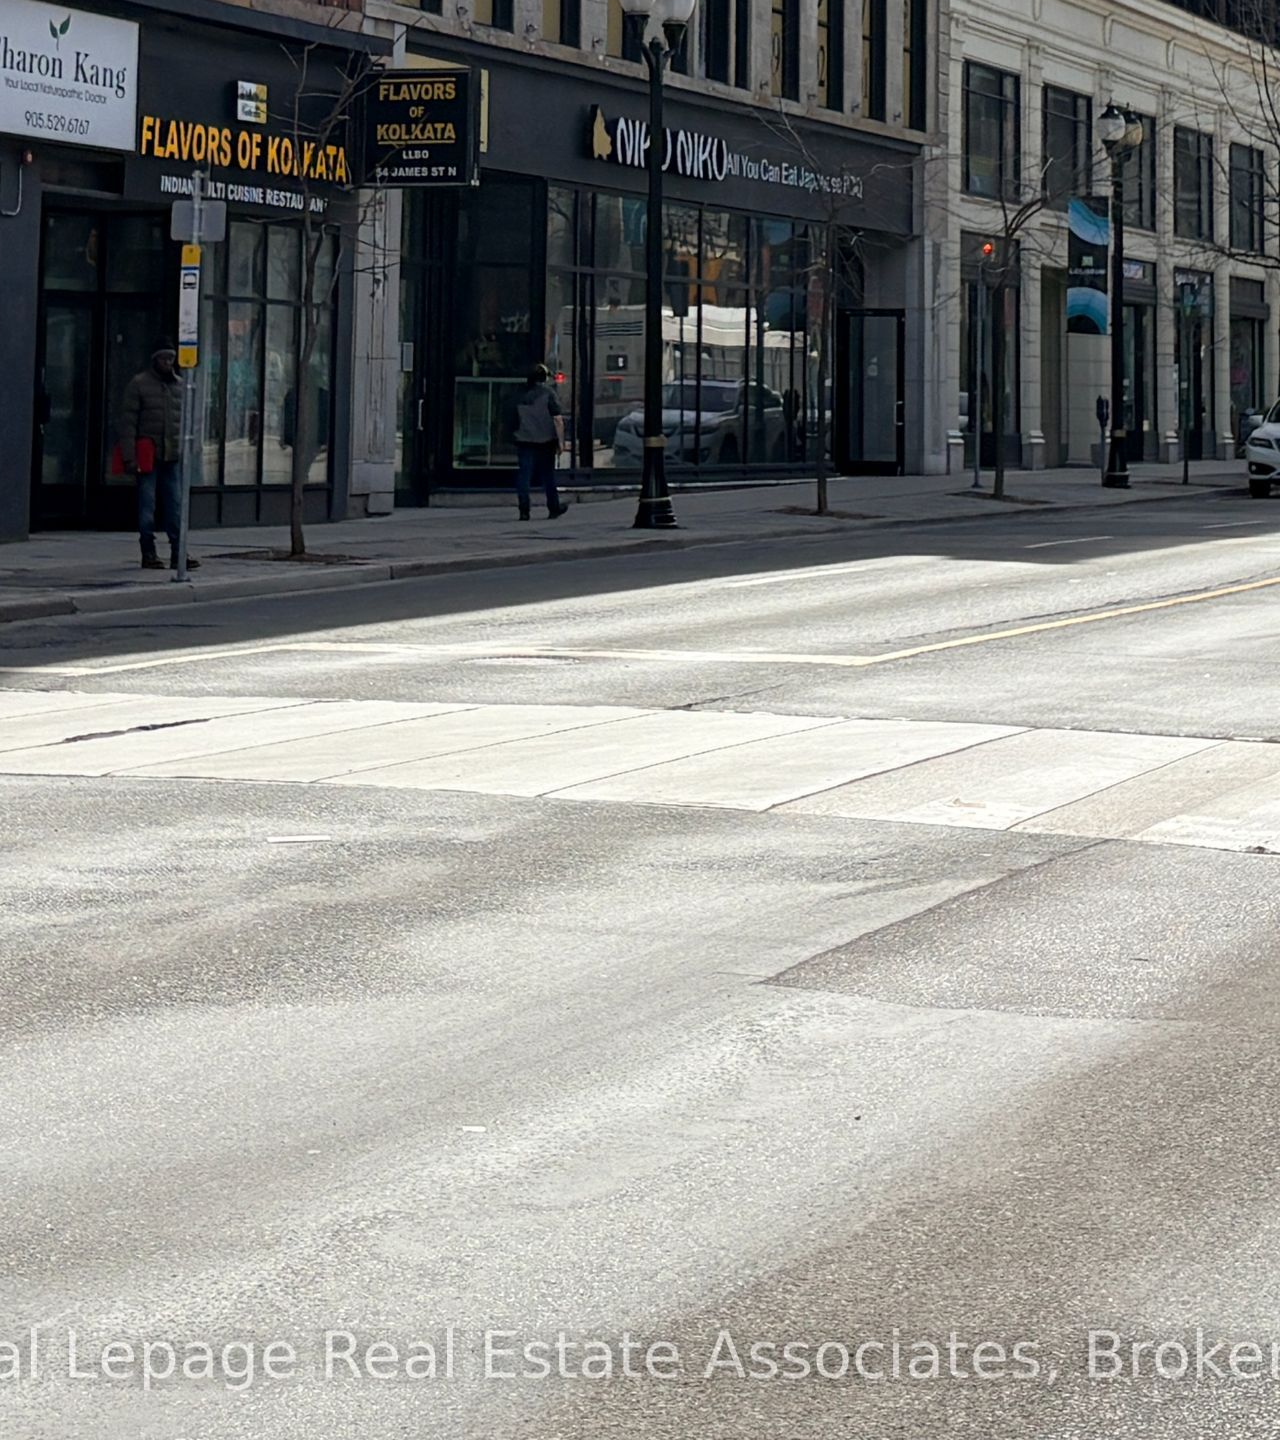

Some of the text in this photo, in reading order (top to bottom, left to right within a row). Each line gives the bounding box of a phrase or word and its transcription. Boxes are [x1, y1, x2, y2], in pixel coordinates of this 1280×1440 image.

[74, 51, 127, 99] Kang
[378, 83, 457, 102] FLAVORS
[408, 105, 425, 119] OF
[140, 115, 232, 168] FLAVORS
[237, 129, 262, 171] OF
[376, 122, 456, 140] KOLKATA
[390, 166, 429, 178] JAMES
[431, 166, 445, 177] ST
[447, 166, 458, 177] N
[741, 155, 760, 180] You
[760, 158, 780, 184] Can
[227, 183, 265, 206] CUISINE
[265, 188, 328, 214] RESTAUAN
